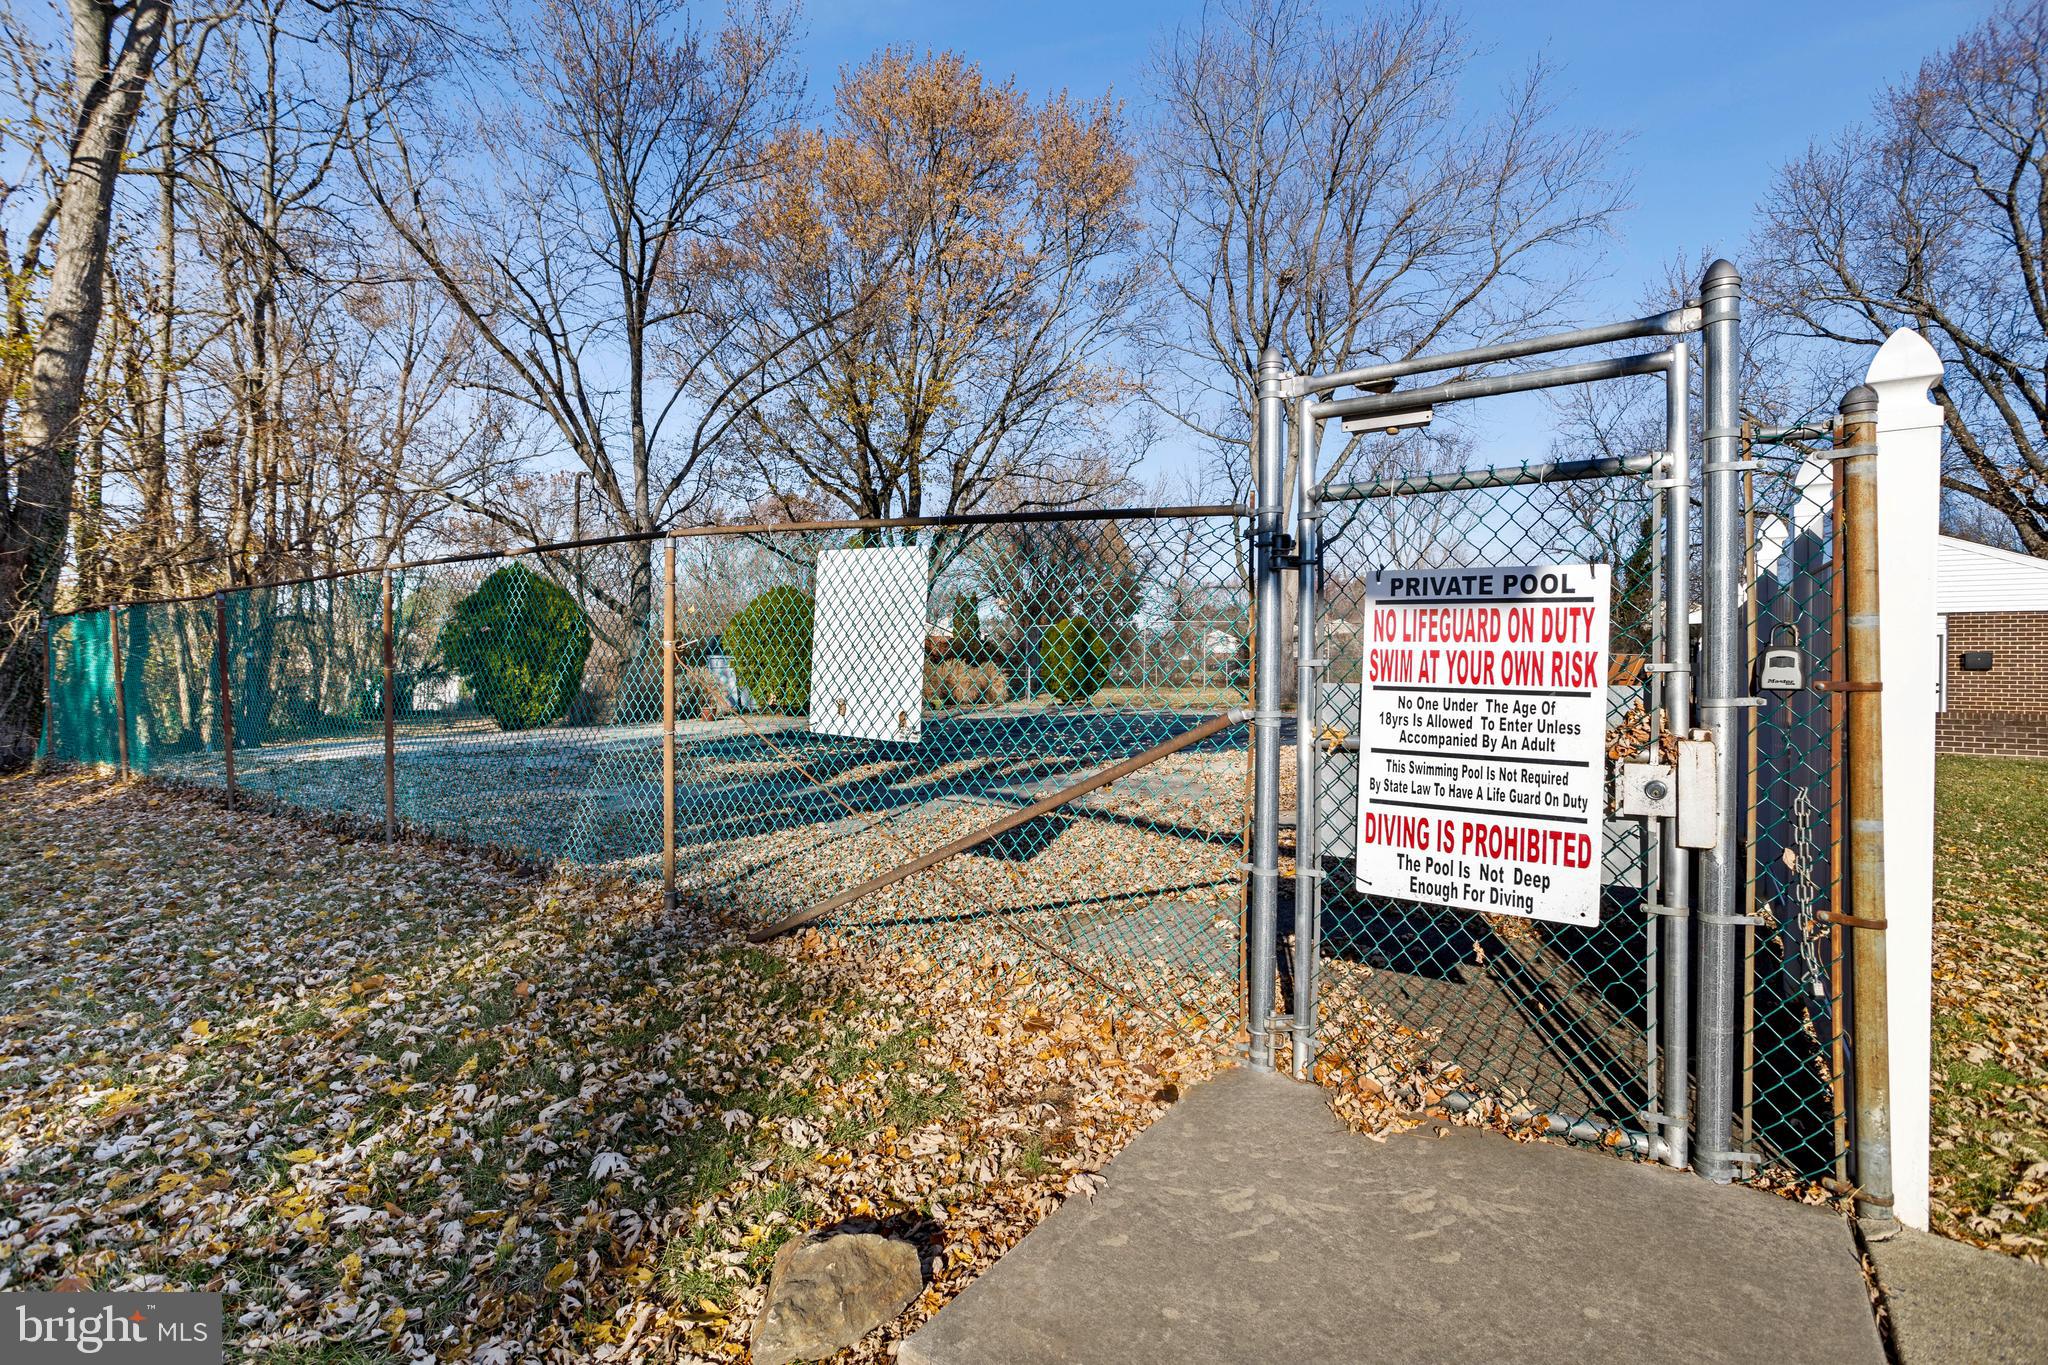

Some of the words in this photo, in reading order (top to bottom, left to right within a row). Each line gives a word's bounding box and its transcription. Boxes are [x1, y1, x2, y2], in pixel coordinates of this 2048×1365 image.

[1391, 575, 1493, 596] PRIVATE
[1502, 573, 1576, 594] POOL
[1374, 609, 1396, 642] NO
[1403, 608, 1501, 642] LIFEGUARD
[1508, 607, 1534, 643] ON
[1542, 607, 1595, 643] DUTY
[1370, 649, 1412, 682] SWIM
[1418, 650, 1440, 683] AT
[1446, 650, 1494, 685] YOUR
[1501, 650, 1544, 686] OWN
[1552, 651, 1598, 688] RISK
[1380, 712, 1408, 729] 18yrs
[1413, 713, 1422, 727] Is
[1427, 714, 1472, 729] Allowed
[1481, 716, 1494, 730] To
[1500, 717, 1532, 732] Enter
[1538, 719, 1580, 735] Unless
[1398, 696, 1412, 709] No
[1417, 697, 1438, 710] One
[1444, 697, 1478, 712] Under
[1486, 699, 1508, 713] The
[1513, 700, 1536, 718] Age
[1542, 701, 1556, 715] Of
[1400, 730, 1477, 748] Accompanied
[1483, 734, 1497, 752] By
[1501, 736, 1516, 750] An
[1521, 737, 1555, 752] Adult
[1386, 759, 1405, 773] This
[1409, 761, 1458, 781] Swimming
[1462, 765, 1483, 779] Pool
[1487, 766, 1495, 780] Is
[1499, 767, 1517, 782] Not
[1521, 769, 1568, 787] Required
[1370, 777, 1381, 794] By
[1384, 779, 1408, 793] State
[1411, 781, 1431, 795] Law
[1434, 783, 1445, 796] To
[1449, 784, 1473, 799] Have
[1476, 786, 1483, 800] A
[1487, 787, 1505, 802] Life
[1510, 789, 1540, 805] Guard
[1545, 792, 1558, 806] On
[1563, 793, 1588, 813] Duty
[1366, 812, 1429, 850] DIVING
[1437, 820, 1454, 853] IS
[1462, 822, 1591, 869] PROHIBITED
[1397, 853, 1420, 872] The
[1426, 857, 1453, 876] Pool
[1459, 861, 1470, 878] Is
[1480, 864, 1504, 883] Not
[1513, 868, 1550, 893] Deep
[1410, 876, 1457, 902] Enough
[1464, 884, 1485, 902] For
[1490, 887, 1533, 915] Diving
